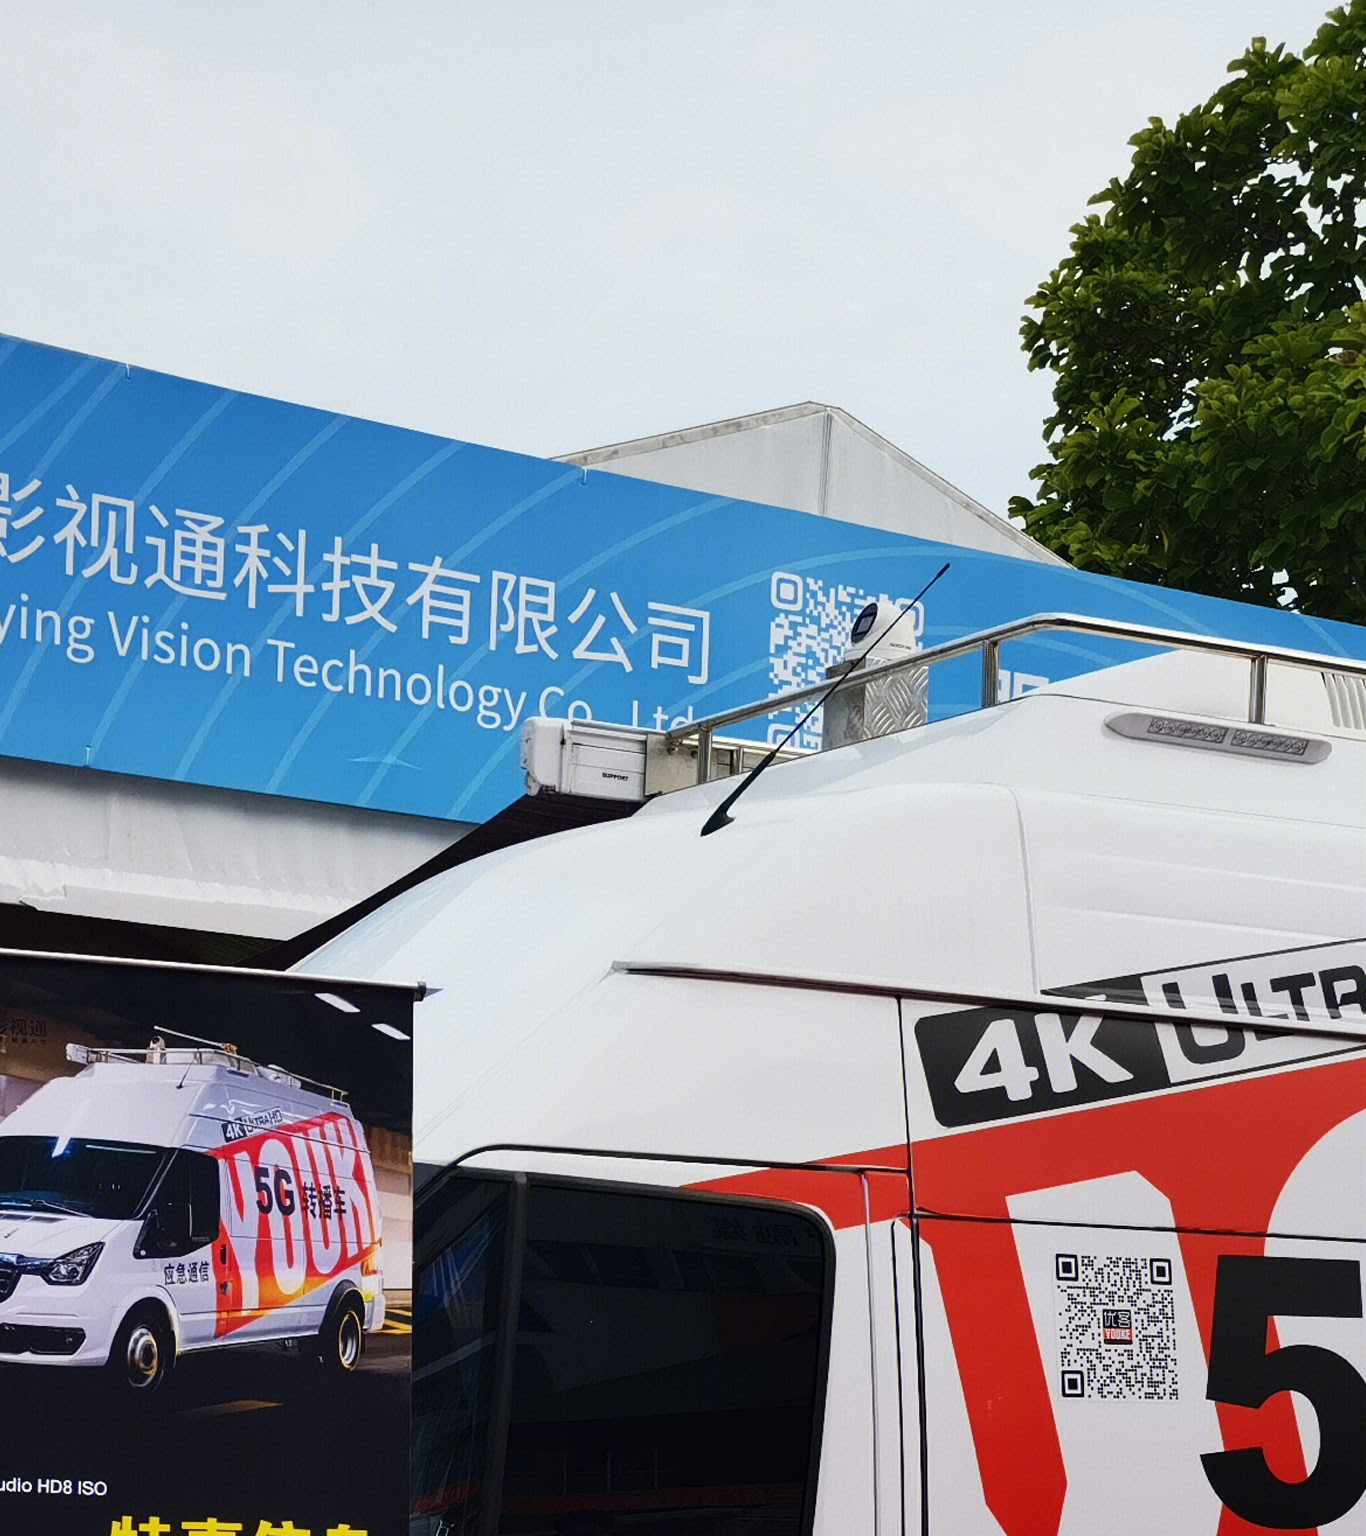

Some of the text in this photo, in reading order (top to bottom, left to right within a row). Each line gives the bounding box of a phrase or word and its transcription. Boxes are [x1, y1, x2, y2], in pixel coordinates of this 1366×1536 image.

[108, 610, 252, 677] Vision
[267, 639, 529, 731] Technology
[953, 995, 1134, 1101] 4K
[164, 1261, 211, 1286] 应急通信
[37, 1479, 72, 1494] HD8
[78, 1481, 107, 1496] ISO
